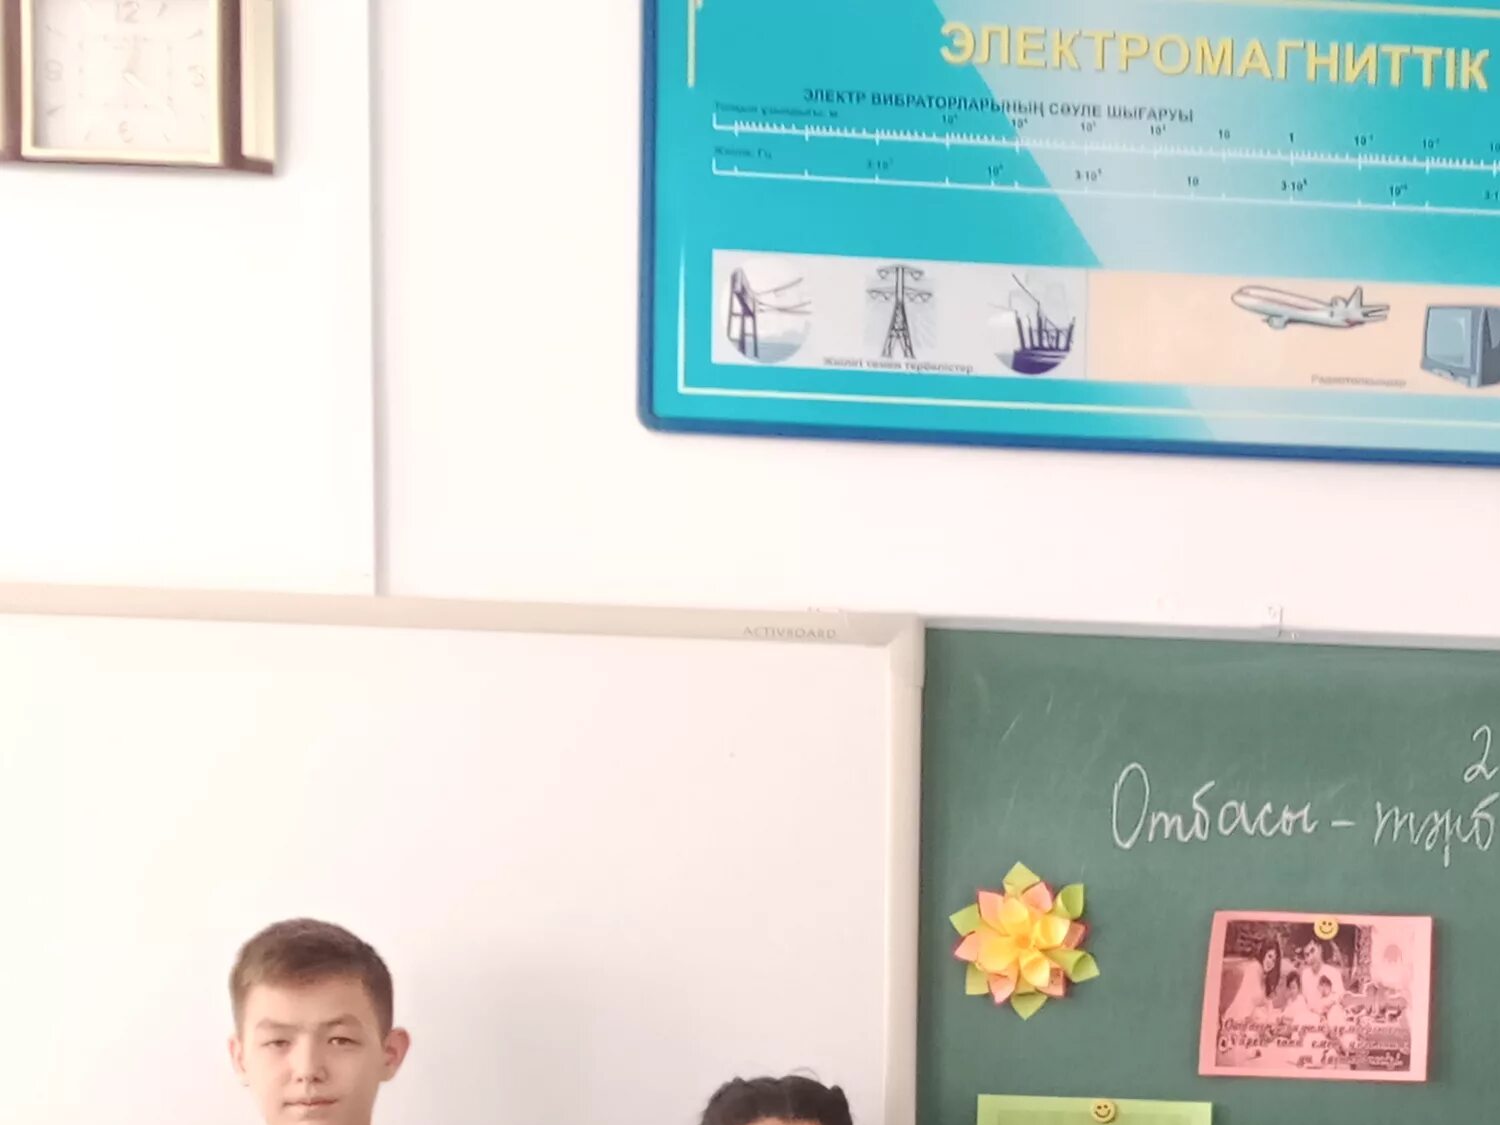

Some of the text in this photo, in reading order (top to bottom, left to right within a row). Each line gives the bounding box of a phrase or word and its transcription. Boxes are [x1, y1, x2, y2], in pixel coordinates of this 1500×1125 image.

[939, 21, 1490, 91] ЭЛЕКТРОМАГНИТТІК
[803, 89, 867, 104] ЭЛЕКТР
[743, 625, 837, 640] ACTIVBOARD
[1110, 762, 1320, 852] Отбасы
